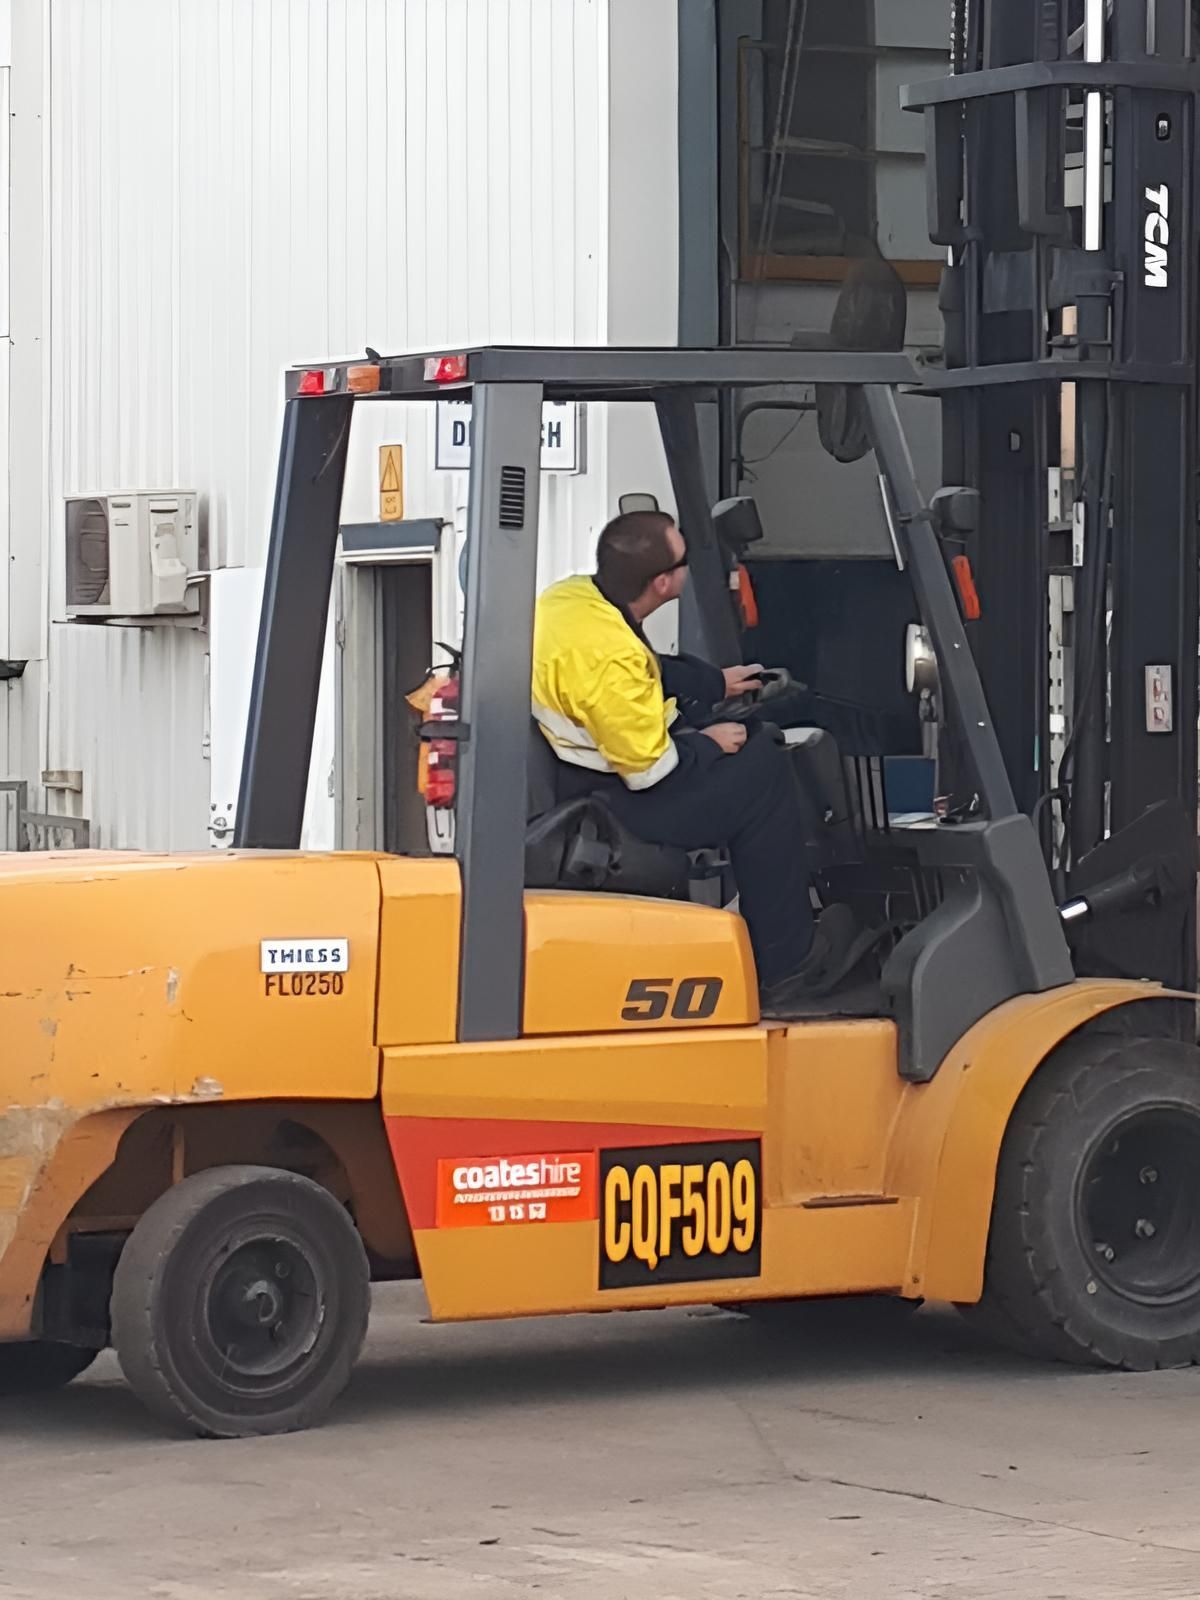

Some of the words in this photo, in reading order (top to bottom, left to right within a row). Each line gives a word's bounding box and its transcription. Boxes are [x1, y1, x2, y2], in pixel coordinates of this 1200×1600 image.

[1144, 184, 1169, 287] TCM
[265, 973, 344, 996] FL0250
[621, 976, 724, 1021] 50
[604, 1159, 756, 1271] CQF509
